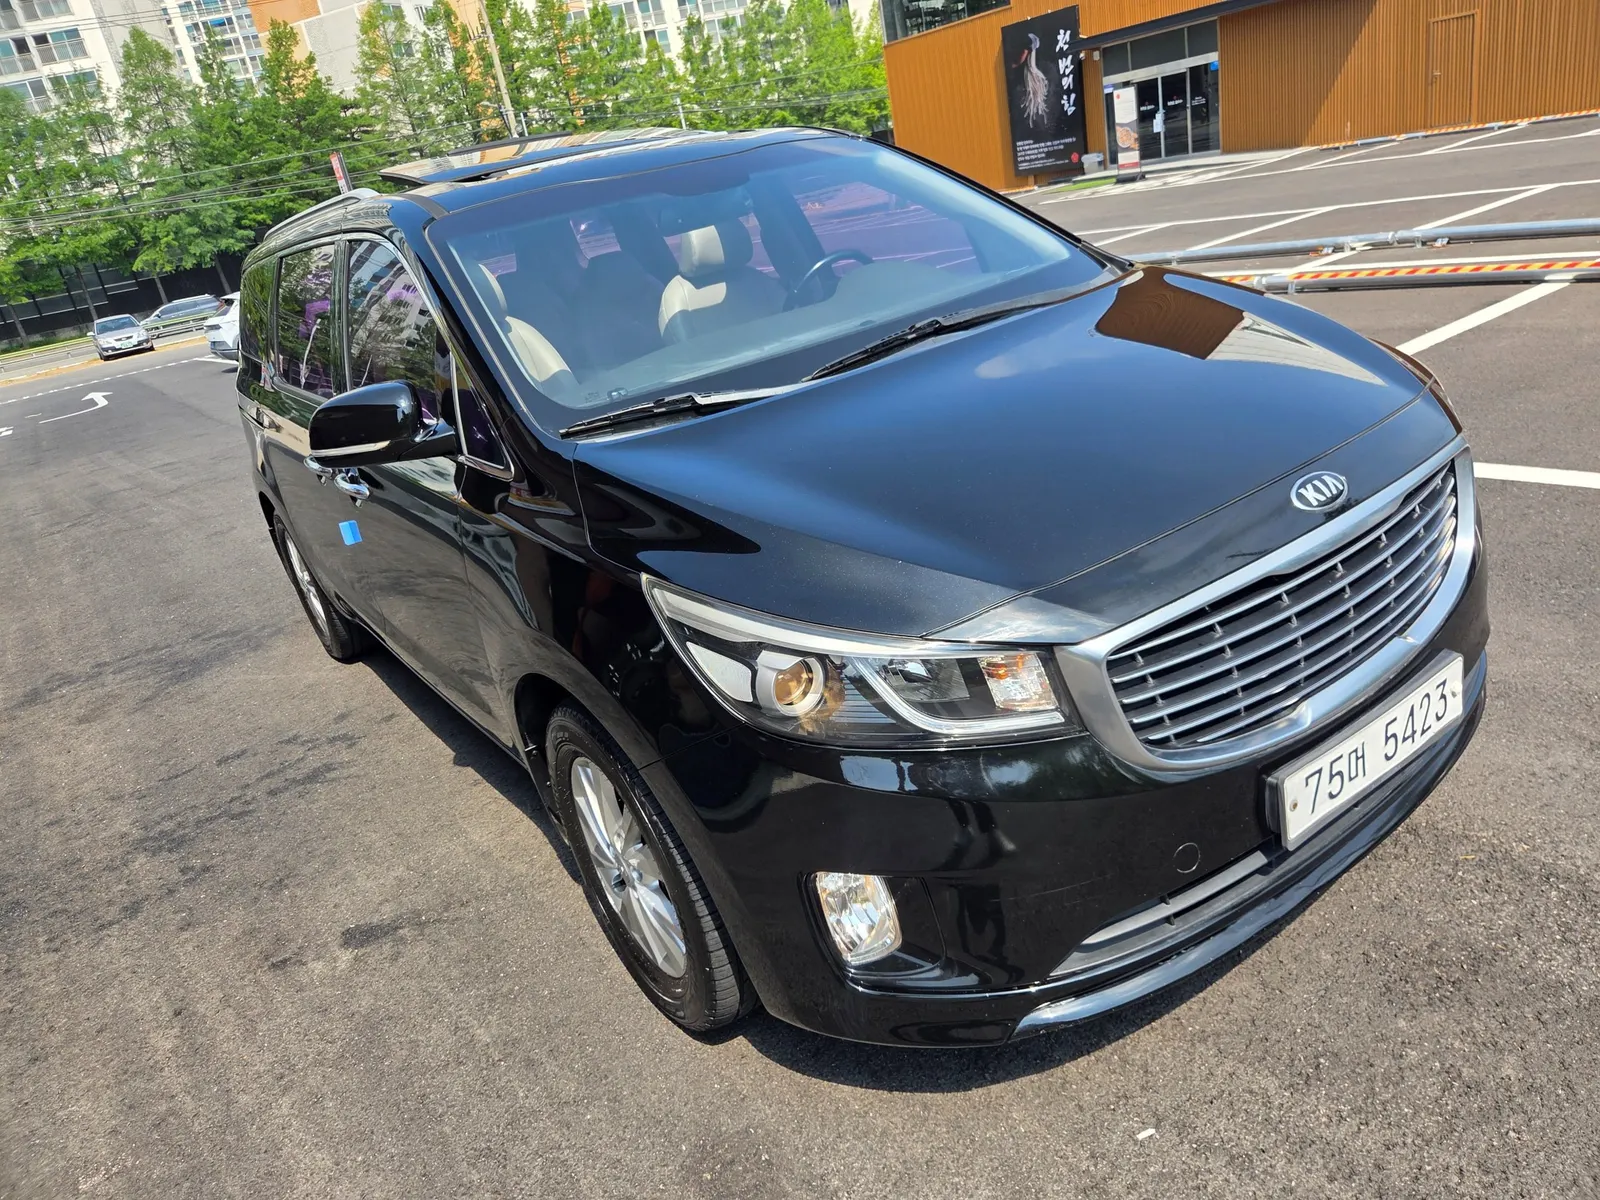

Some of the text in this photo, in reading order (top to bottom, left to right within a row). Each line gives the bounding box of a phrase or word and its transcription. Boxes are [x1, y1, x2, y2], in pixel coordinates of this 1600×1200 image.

[1056, 29, 1071, 52] 천
[1061, 92, 1076, 115] 힘
[1297, 475, 1344, 506] KIA
[1305, 678, 1448, 814] 75머 5423
